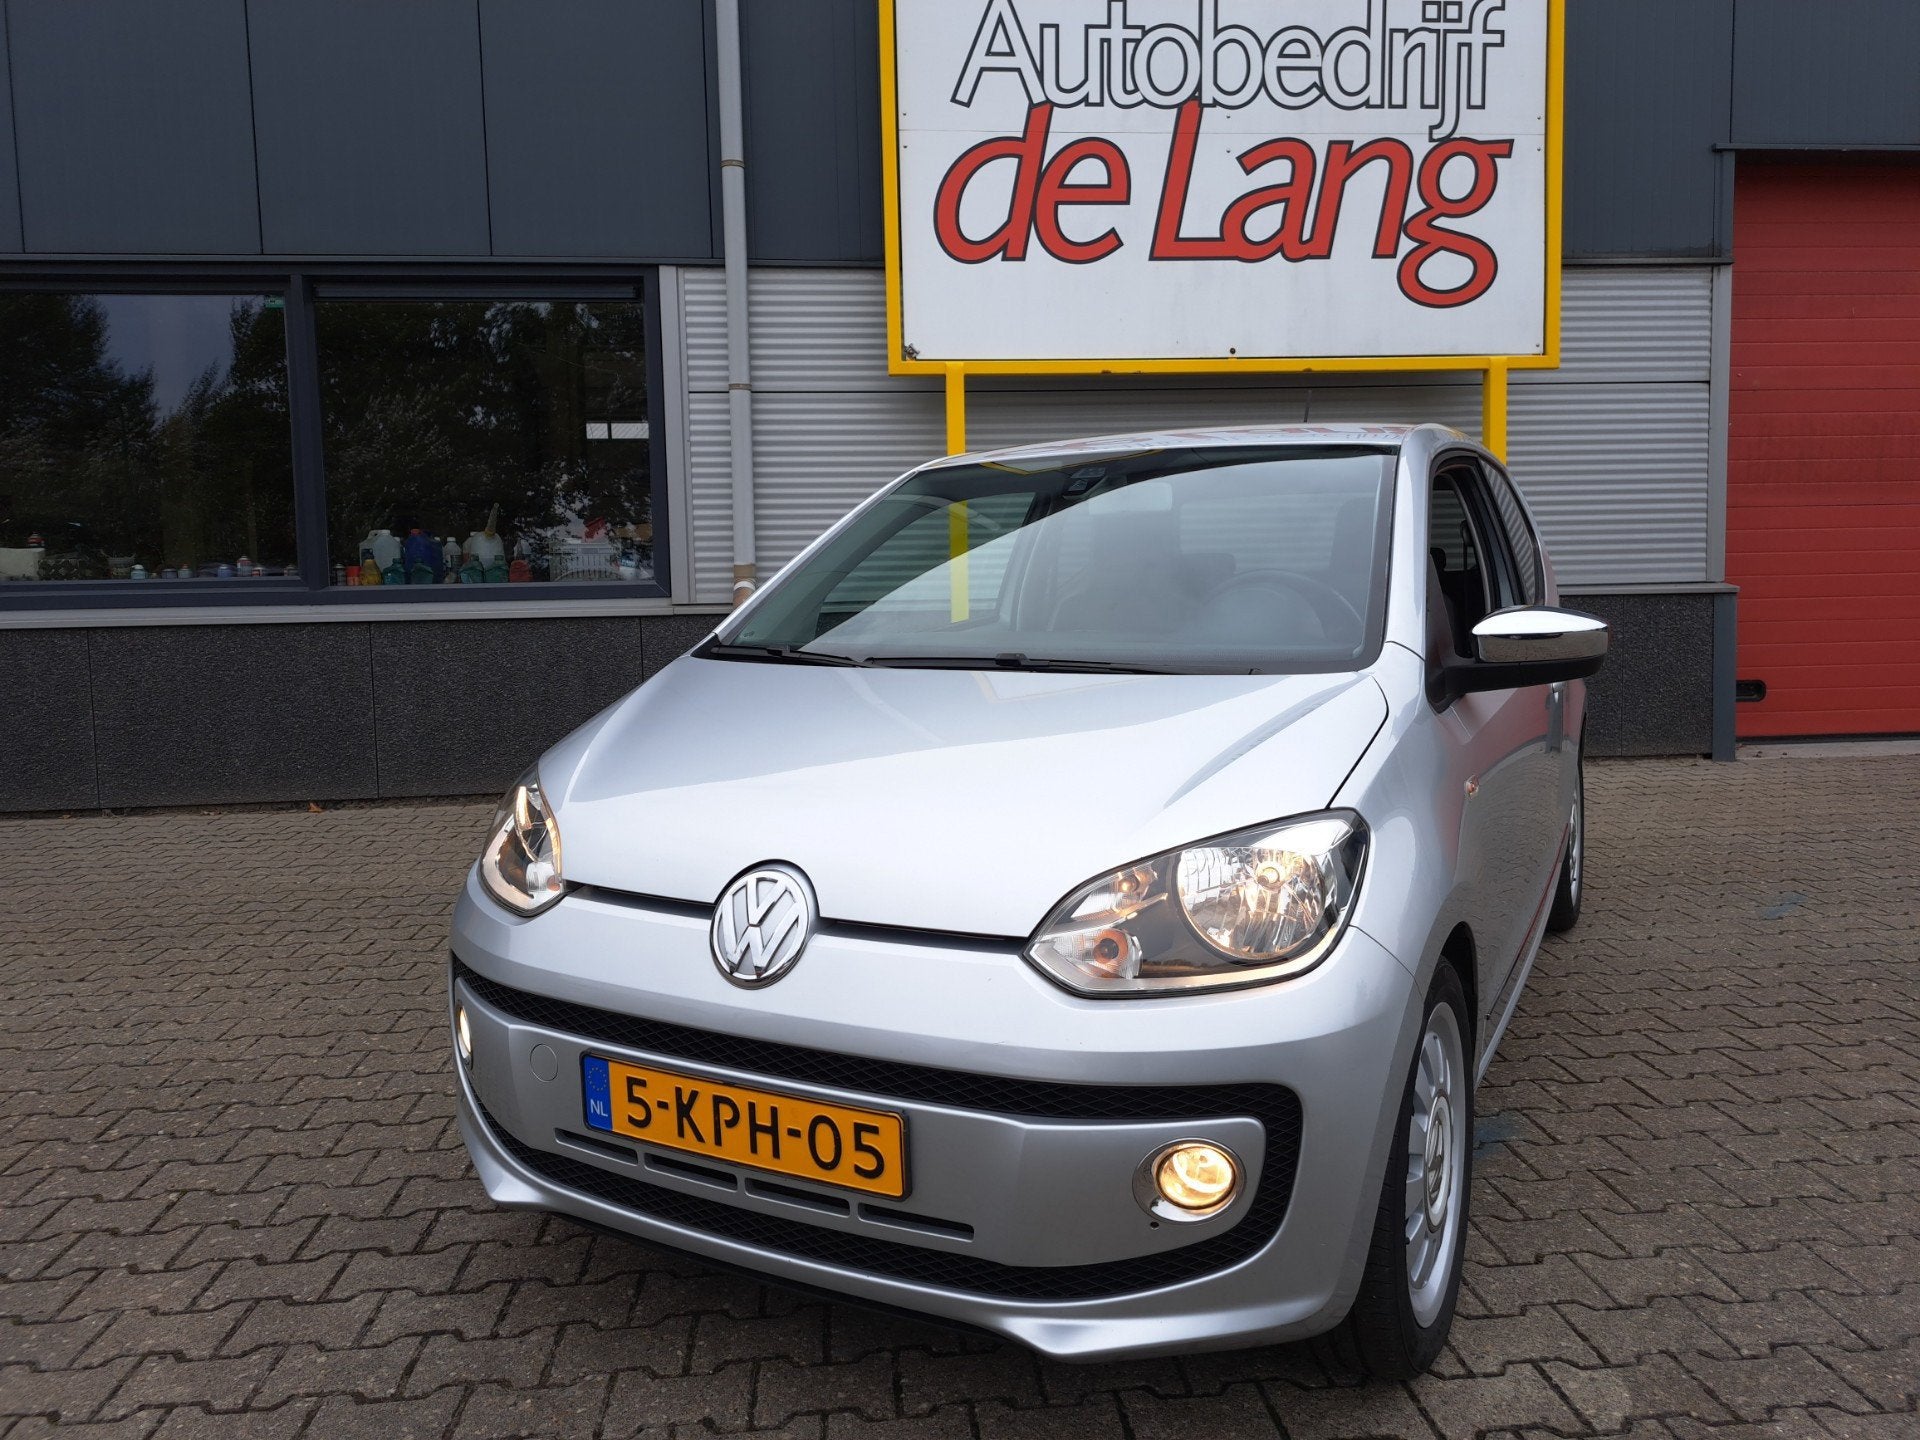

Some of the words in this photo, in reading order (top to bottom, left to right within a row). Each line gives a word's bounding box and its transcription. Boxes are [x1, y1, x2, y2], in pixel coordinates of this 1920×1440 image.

[951, 0, 1505, 142] Autobedrijf
[932, 103, 1131, 264] de
[1148, 102, 1513, 308] Lang
[590, 1098, 609, 1117] NL
[625, 1075, 886, 1180] 5-KPH-05
